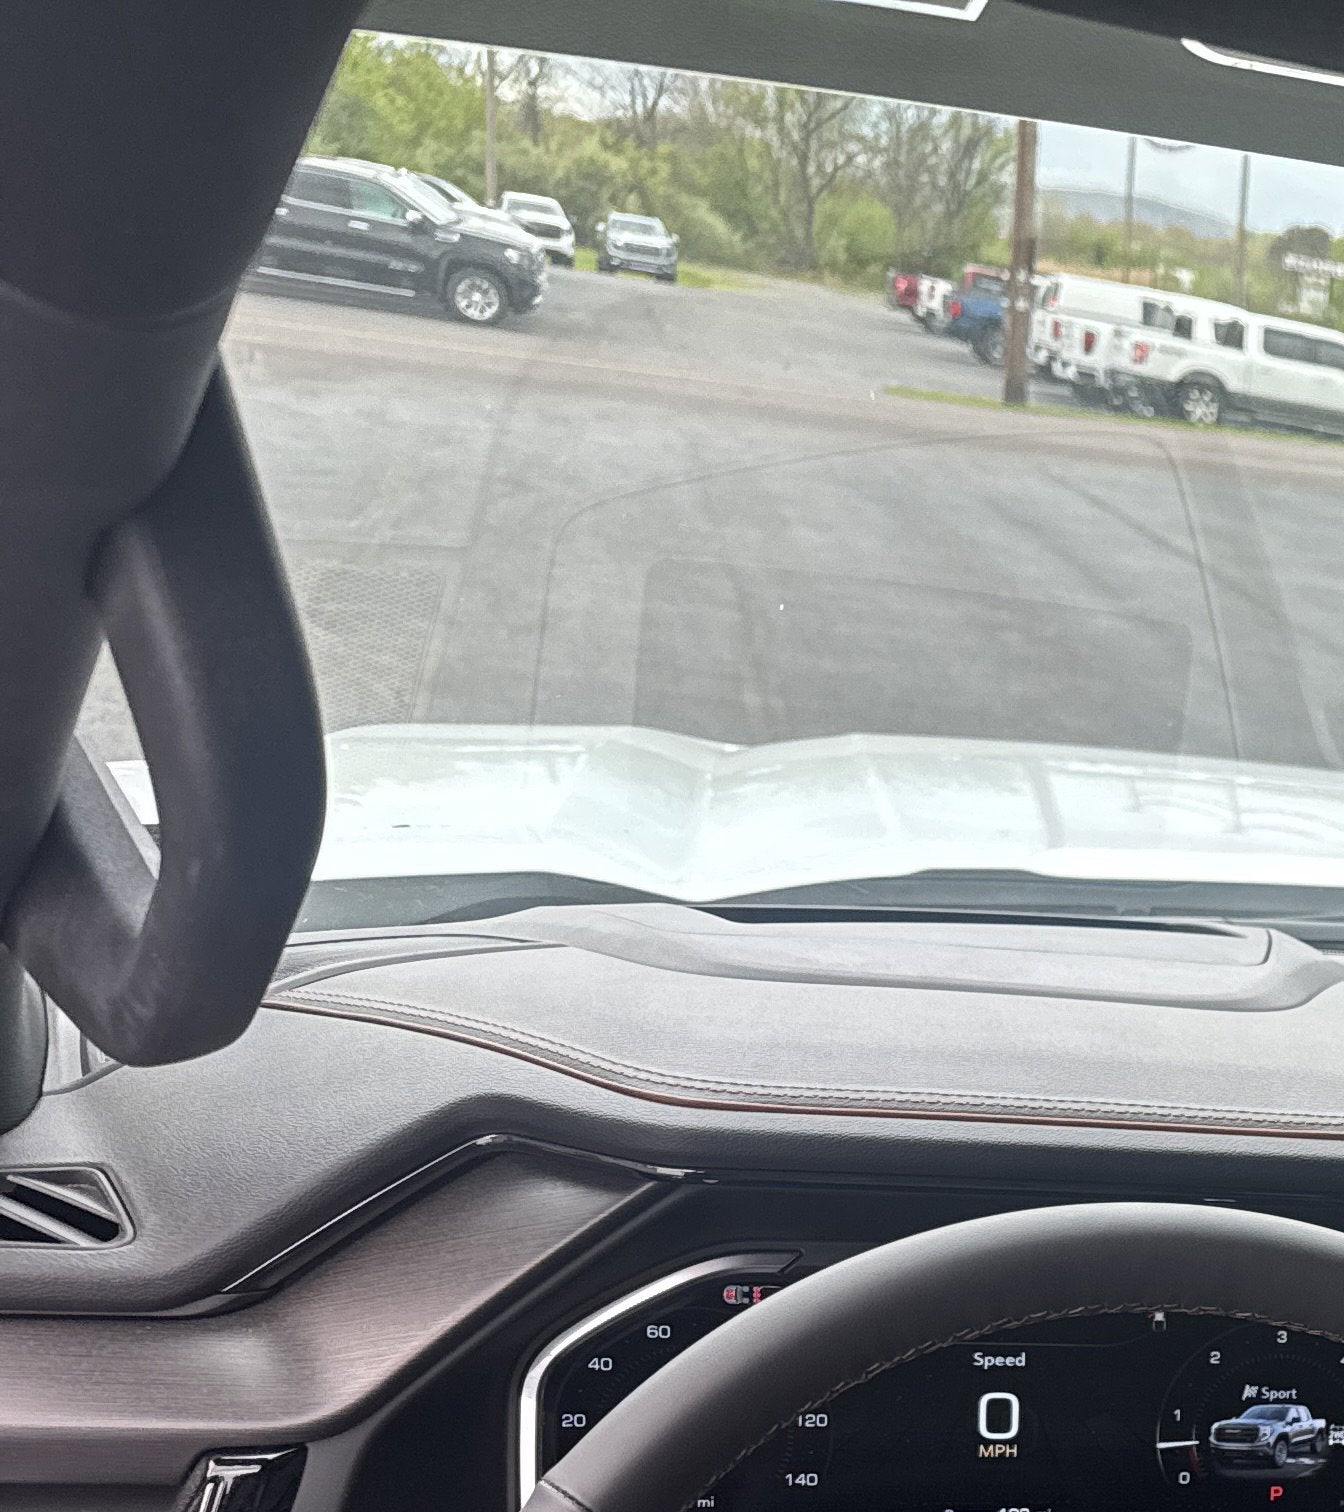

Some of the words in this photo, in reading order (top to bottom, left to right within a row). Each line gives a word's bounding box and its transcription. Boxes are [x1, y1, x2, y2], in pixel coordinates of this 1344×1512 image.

[646, 1325, 672, 1339] 60
[1276, 1330, 1288, 1344] 3
[588, 1357, 613, 1371] 40
[973, 1351, 1026, 1369] Speed
[1209, 1351, 1221, 1364] 2
[1261, 1387, 1298, 1402] Sport
[561, 1413, 587, 1428] 20
[797, 1413, 829, 1428] 120
[978, 1391, 1020, 1440] 0
[1173, 1408, 1182, 1422] 1
[978, 1443, 1018, 1459] MPH
[784, 1473, 819, 1487] 140
[1178, 1472, 1190, 1485] 0
[1269, 1486, 1284, 1501] P
[697, 1496, 715, 1508] mi
